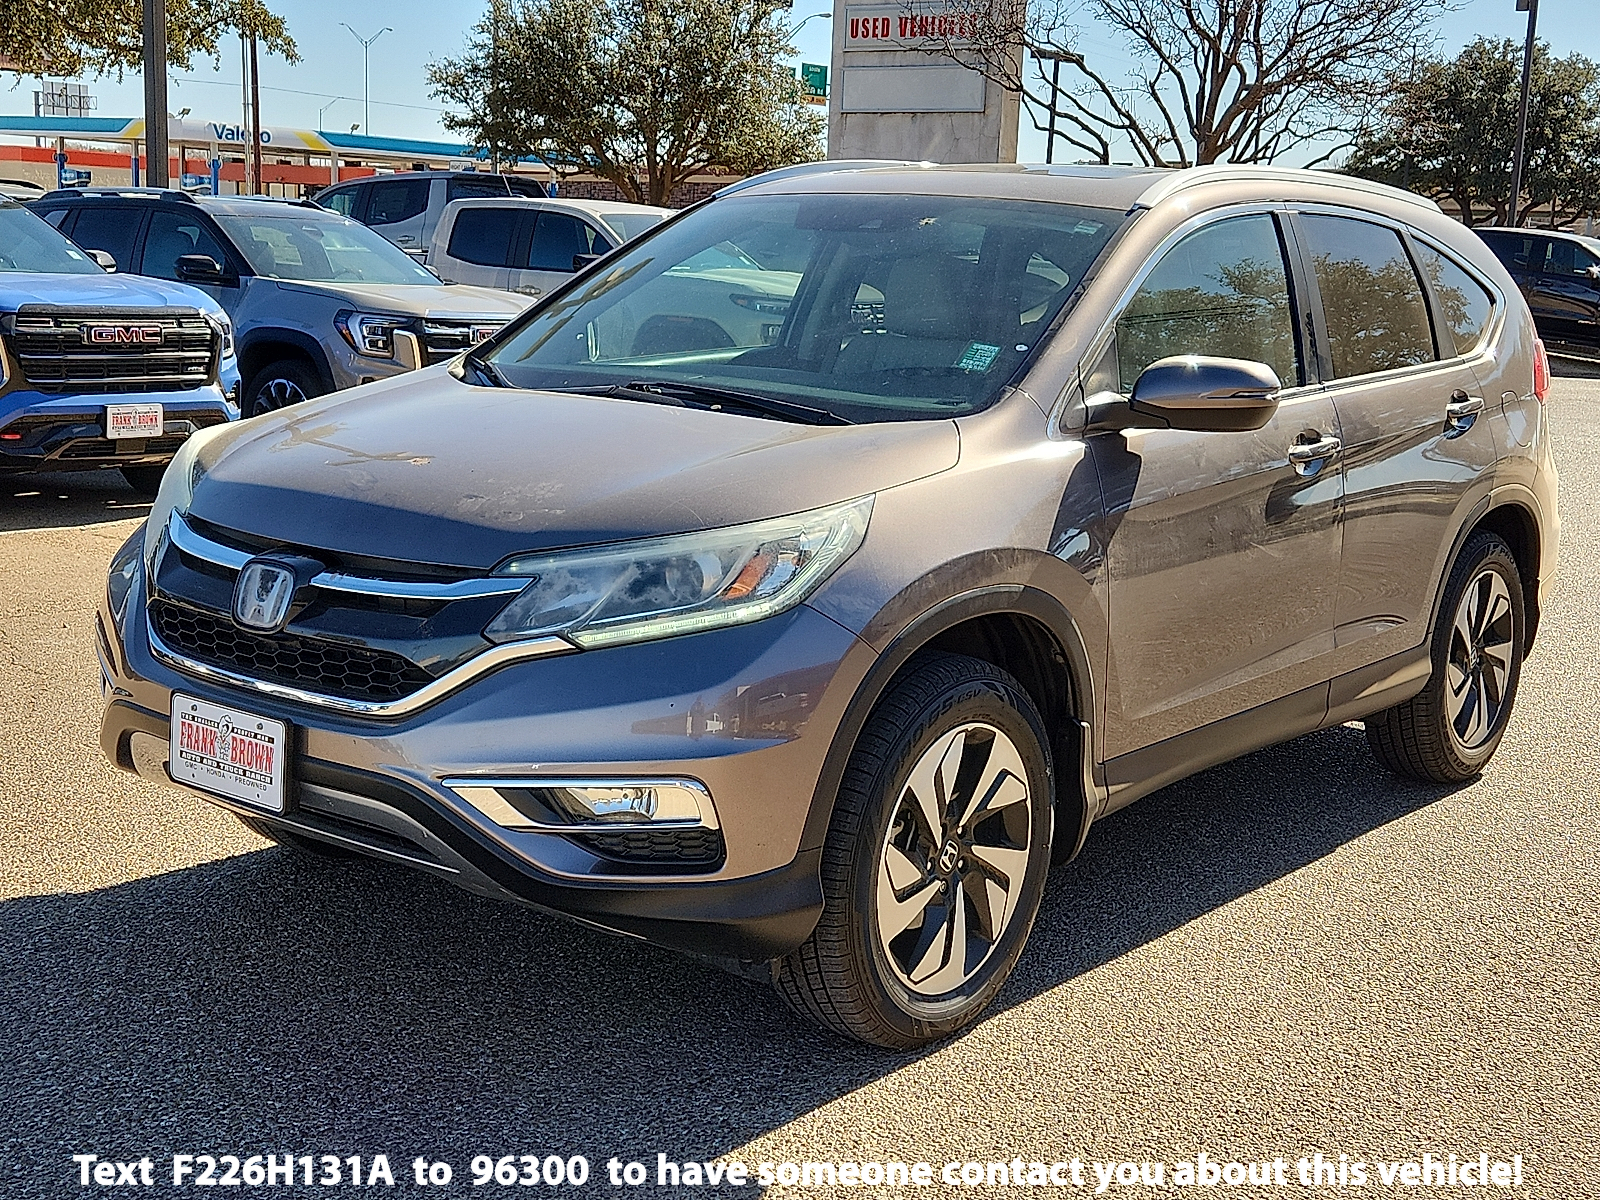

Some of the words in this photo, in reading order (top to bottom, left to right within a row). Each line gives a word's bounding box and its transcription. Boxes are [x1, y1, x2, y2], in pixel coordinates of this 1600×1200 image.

[850, 17, 891, 39] USED
[213, 123, 272, 143] Valeo
[92, 327, 161, 343] GMC
[180, 720, 218, 758] FRANK
[230, 734, 275, 774] BROWN
[181, 751, 201, 762] AUTO
[202, 758, 217, 767] AND
[219, 762, 244, 775] TRUCK
[245, 771, 271, 784] RANCH
[184, 760, 198, 770] GMC
[206, 767, 226, 779] HONDA
[234, 775, 267, 791] PREOWNED
